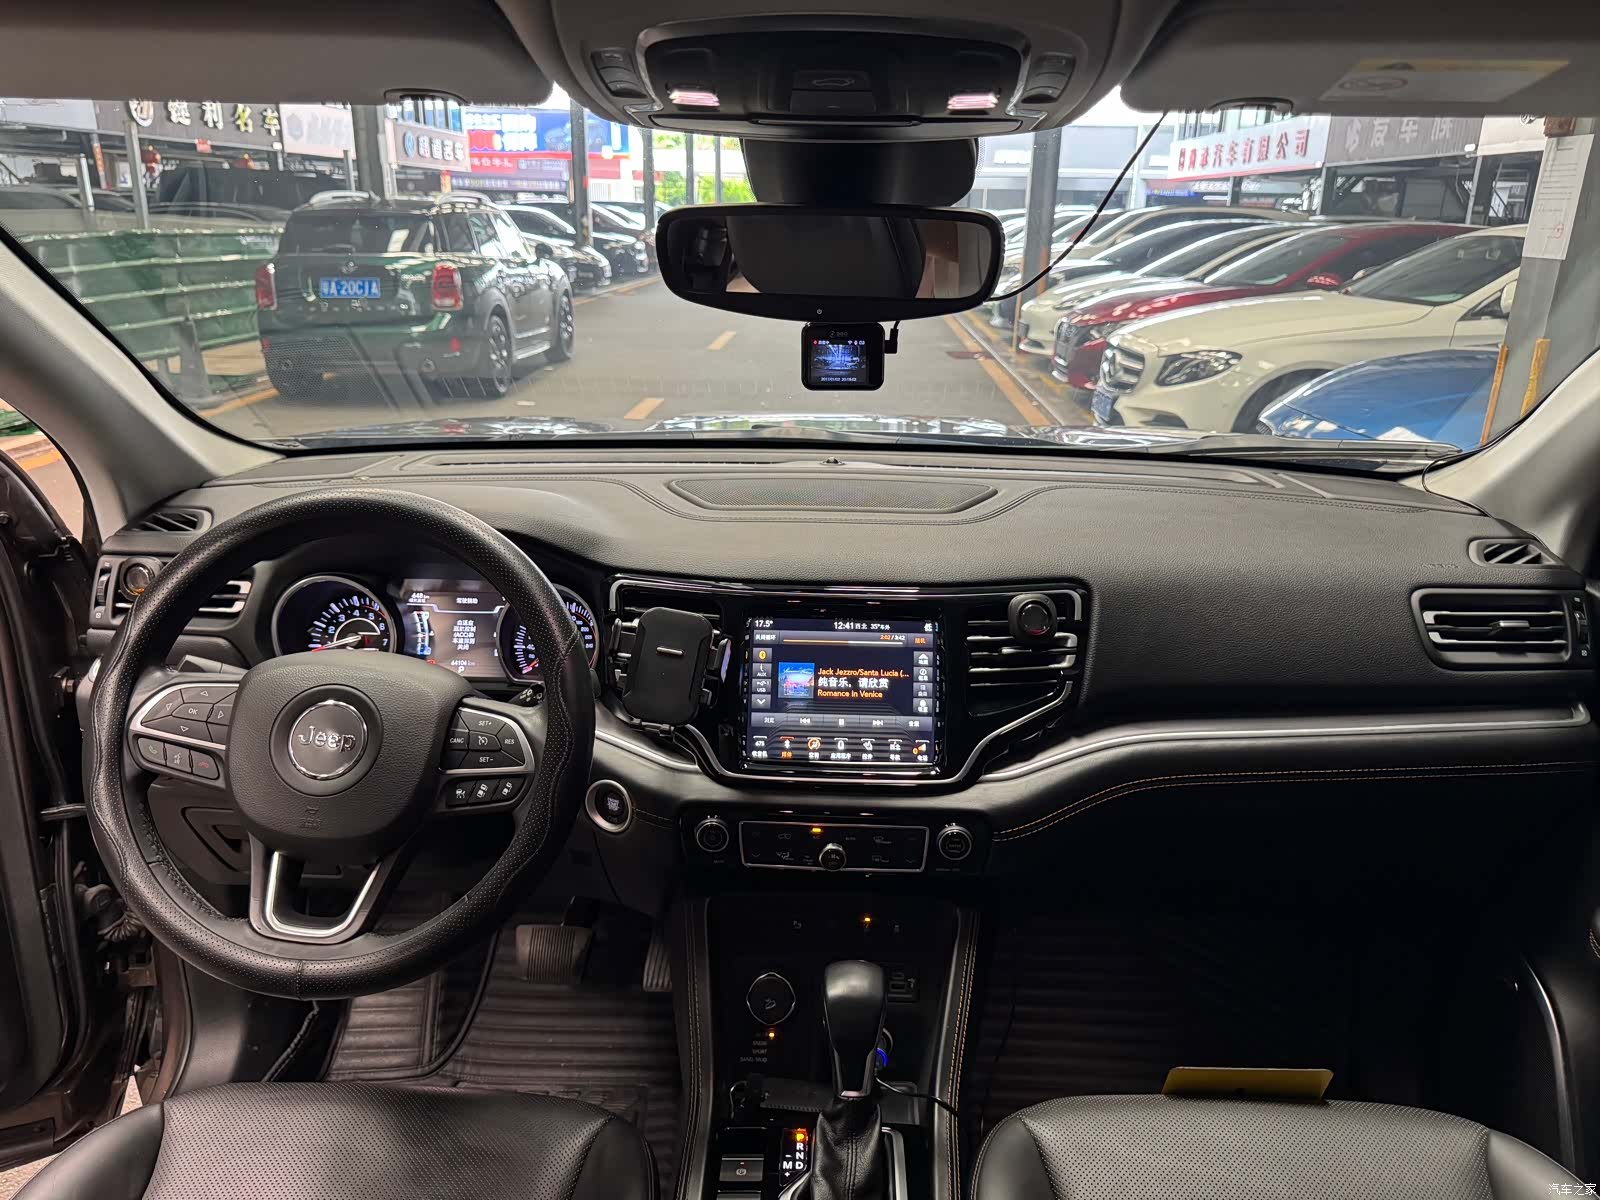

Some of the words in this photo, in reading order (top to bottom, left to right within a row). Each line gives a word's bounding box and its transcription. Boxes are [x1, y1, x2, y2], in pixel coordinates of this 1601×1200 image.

[817, 667, 834, 676] Jack
[880, 669, 898, 677] Lucia
[817, 689, 850, 697] Romance
[859, 690, 883, 699] Venice
[188, 707, 199, 715] OK
[297, 725, 356, 753] Jeep
[796, 1133, 804, 1141] P
[796, 1142, 804, 1151] R
[796, 1152, 804, 1160] N
[783, 1161, 793, 1170] M
[795, 1161, 804, 1170] D
